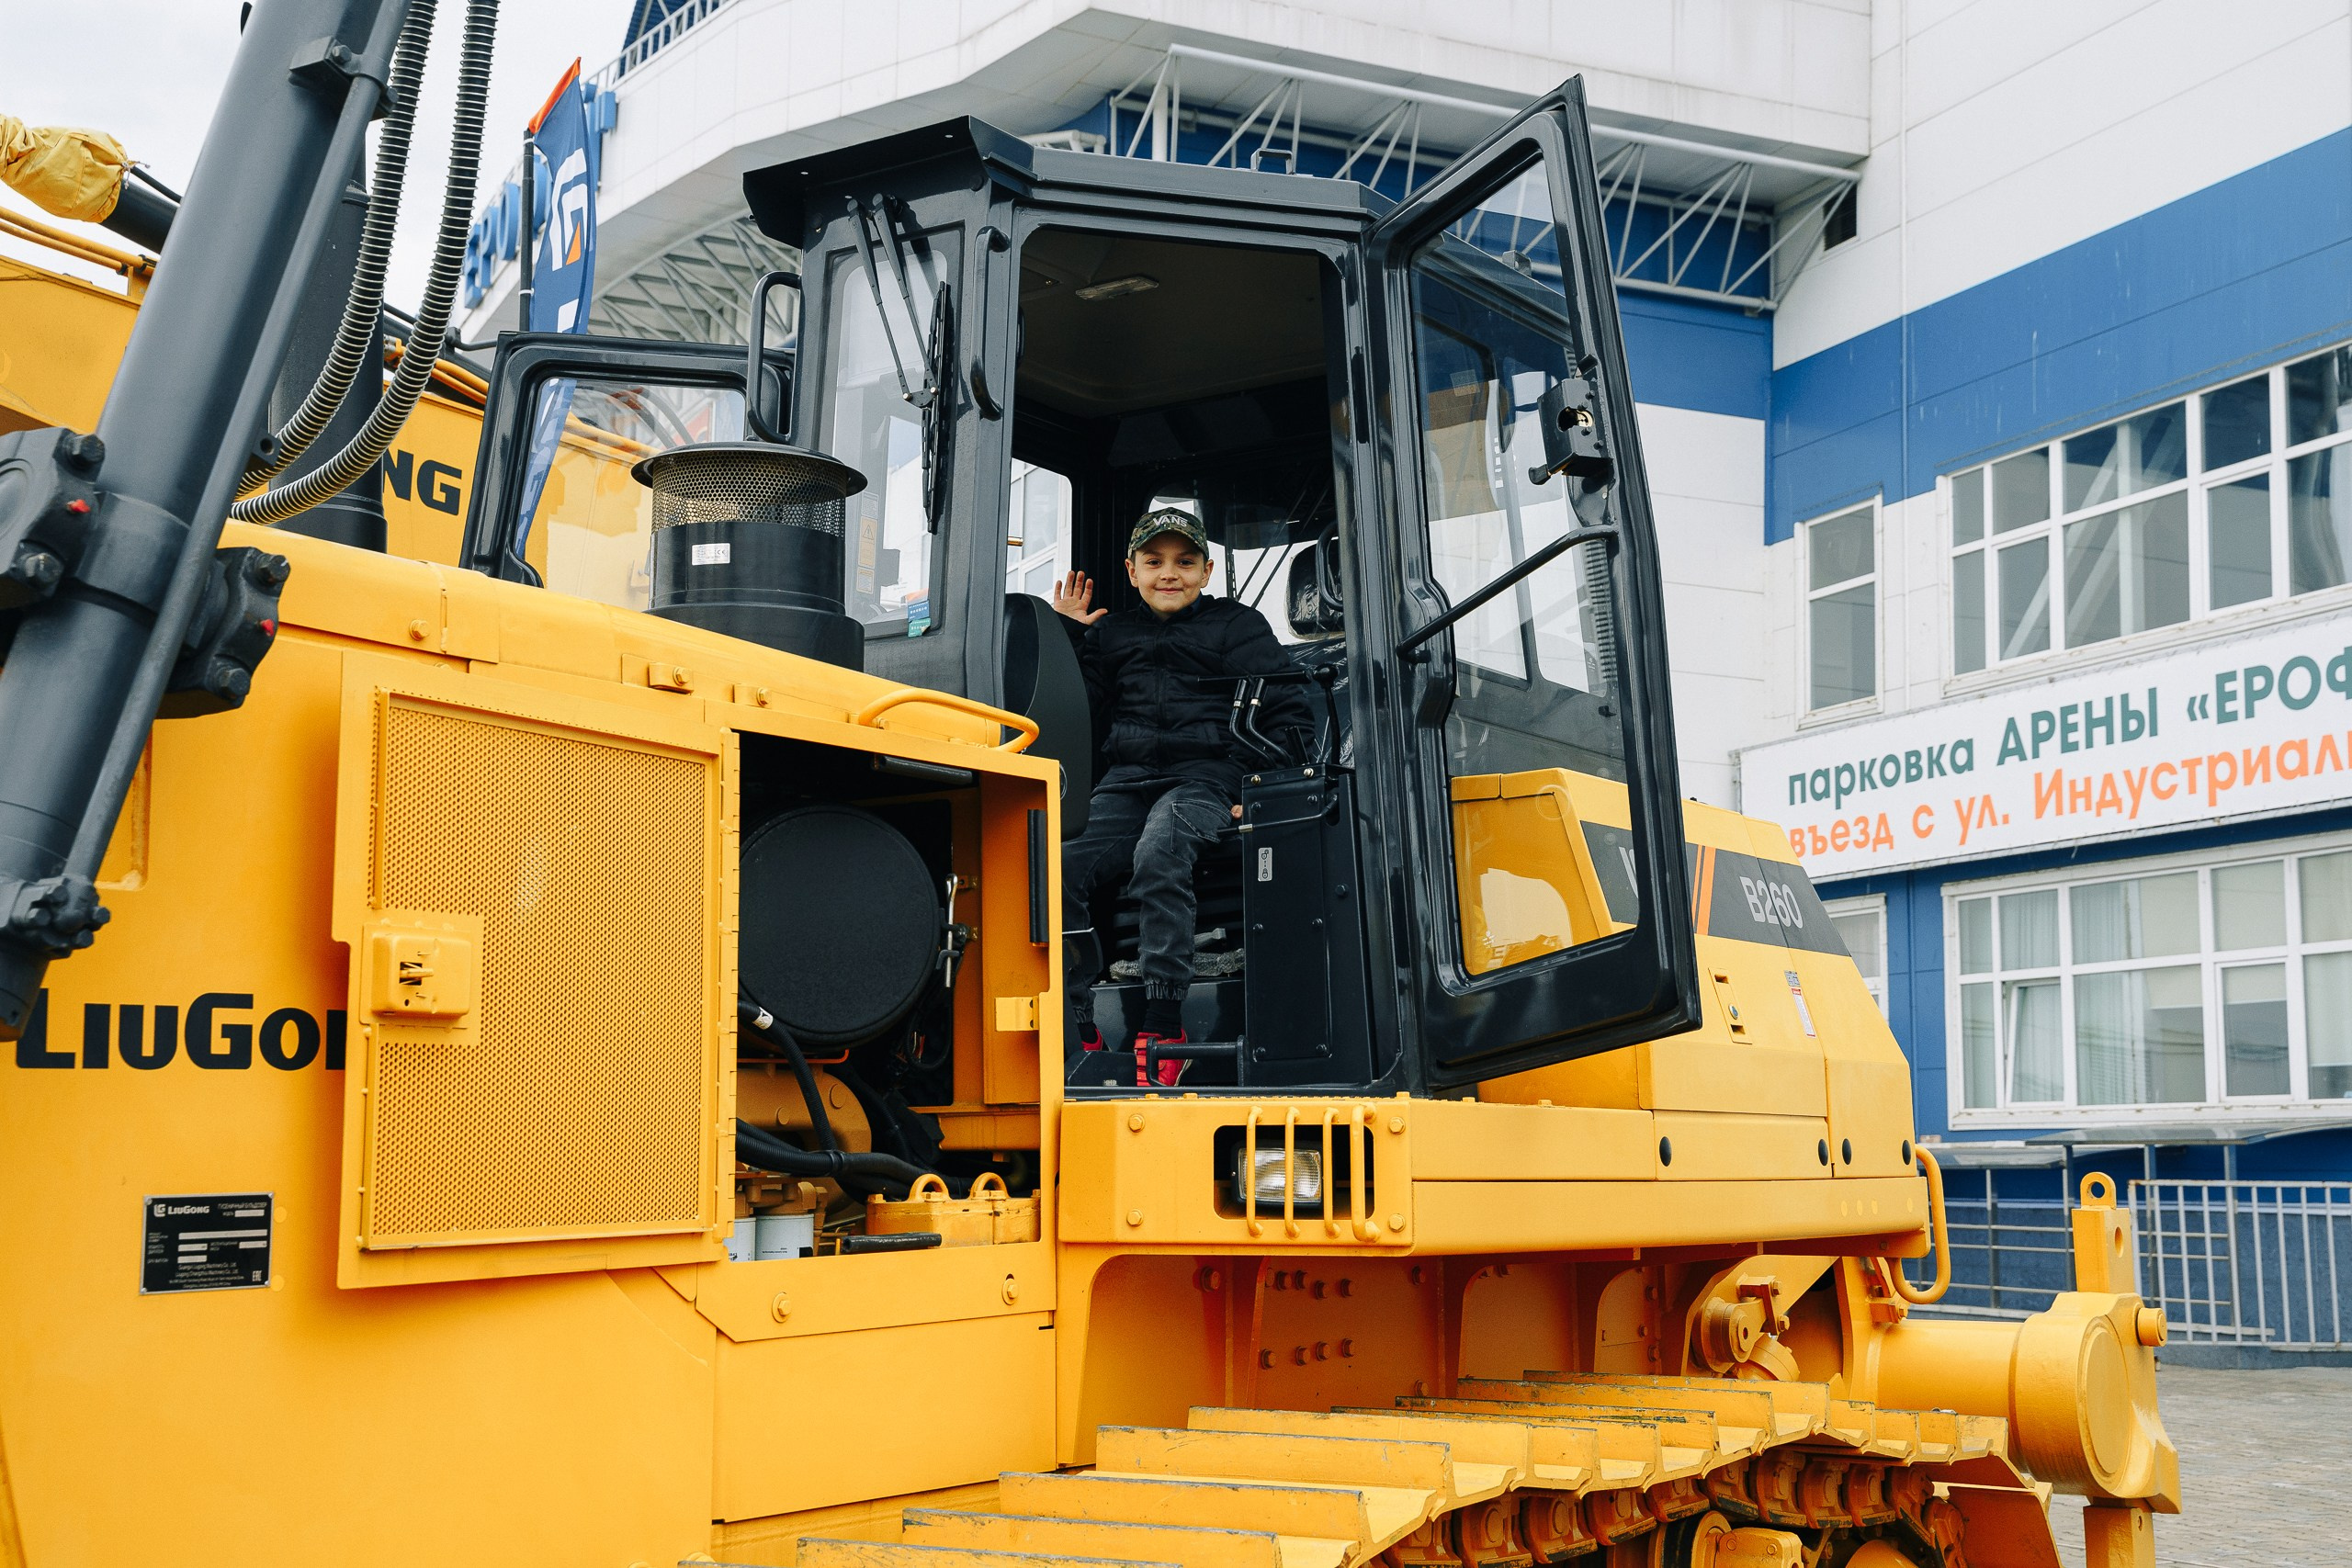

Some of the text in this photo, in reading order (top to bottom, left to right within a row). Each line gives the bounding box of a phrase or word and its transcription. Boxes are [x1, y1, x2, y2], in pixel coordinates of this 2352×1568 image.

[1153, 513, 1188, 528] VANS
[1789, 738, 1974, 810] парковка
[1996, 687, 2158, 766] АРЕНЫ
[1790, 730, 2352, 859] въезд с ул. Индустриал
[1739, 875, 1804, 930] B260
